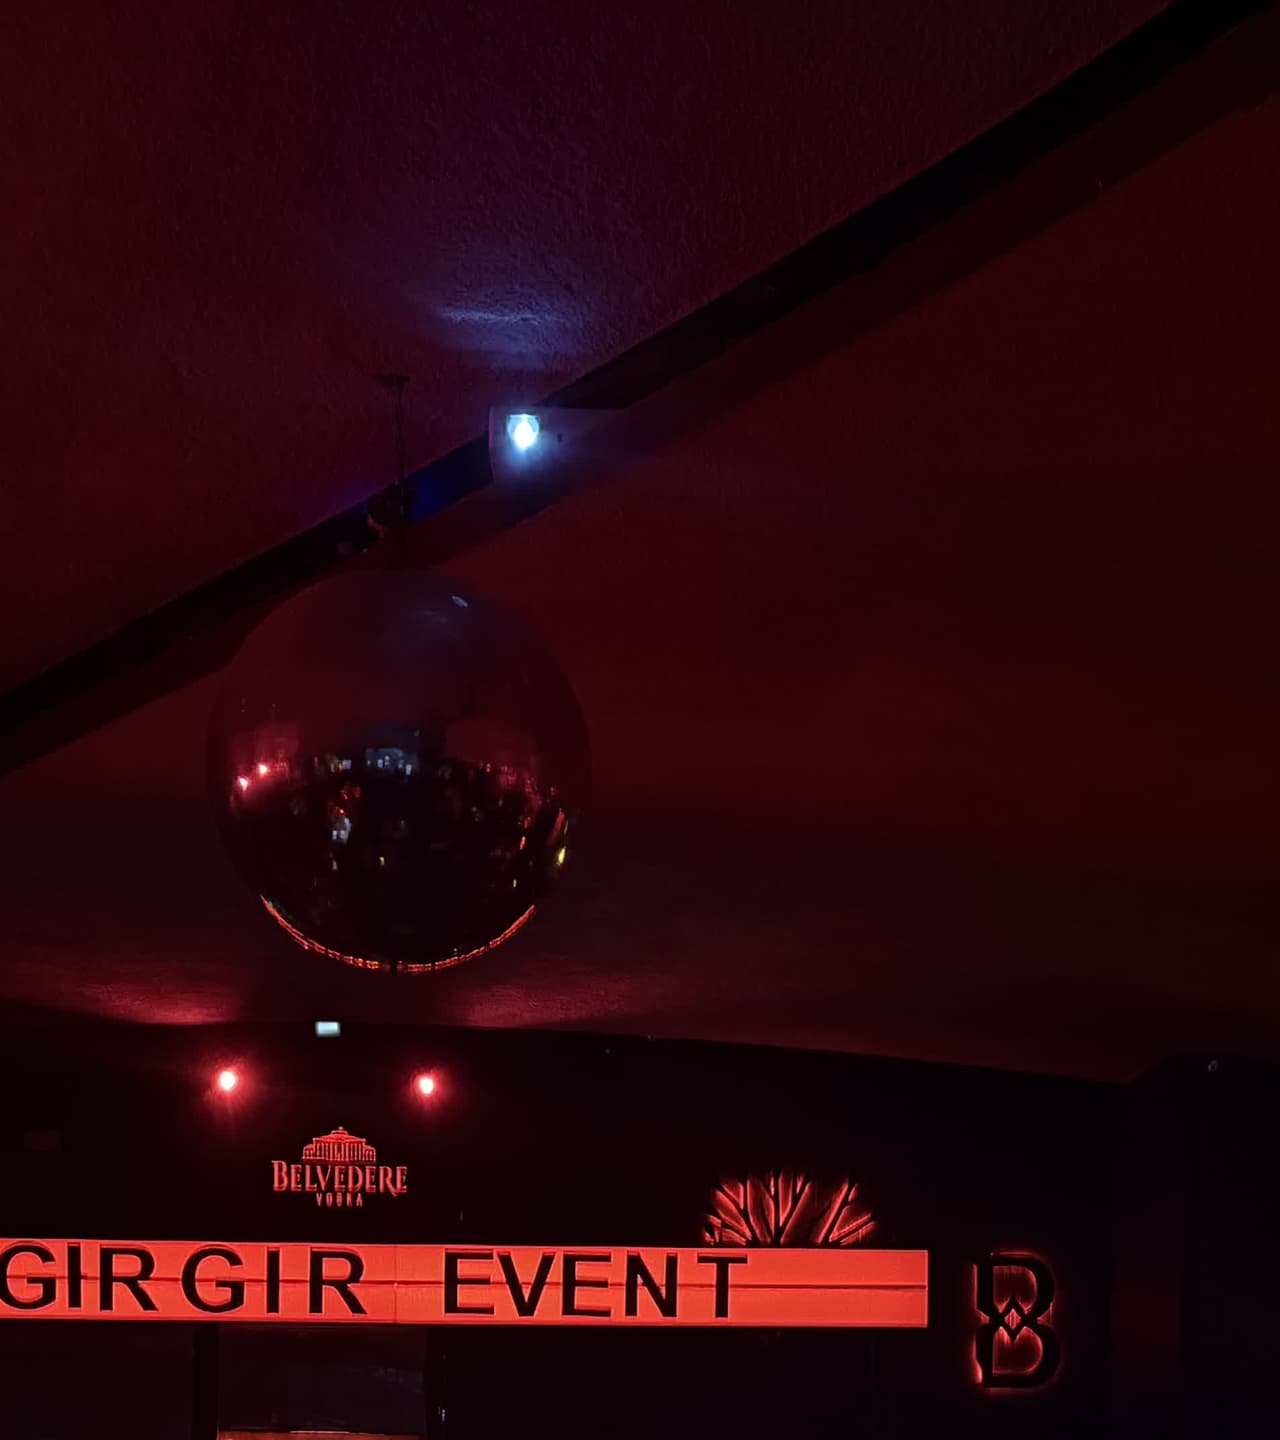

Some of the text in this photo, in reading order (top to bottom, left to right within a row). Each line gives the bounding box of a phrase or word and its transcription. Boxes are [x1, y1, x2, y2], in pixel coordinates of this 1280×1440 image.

[271, 1160, 407, 1197] BELVEDERE
[316, 1193, 363, 1207] VODKA
[443, 1248, 748, 1319] EVENT
